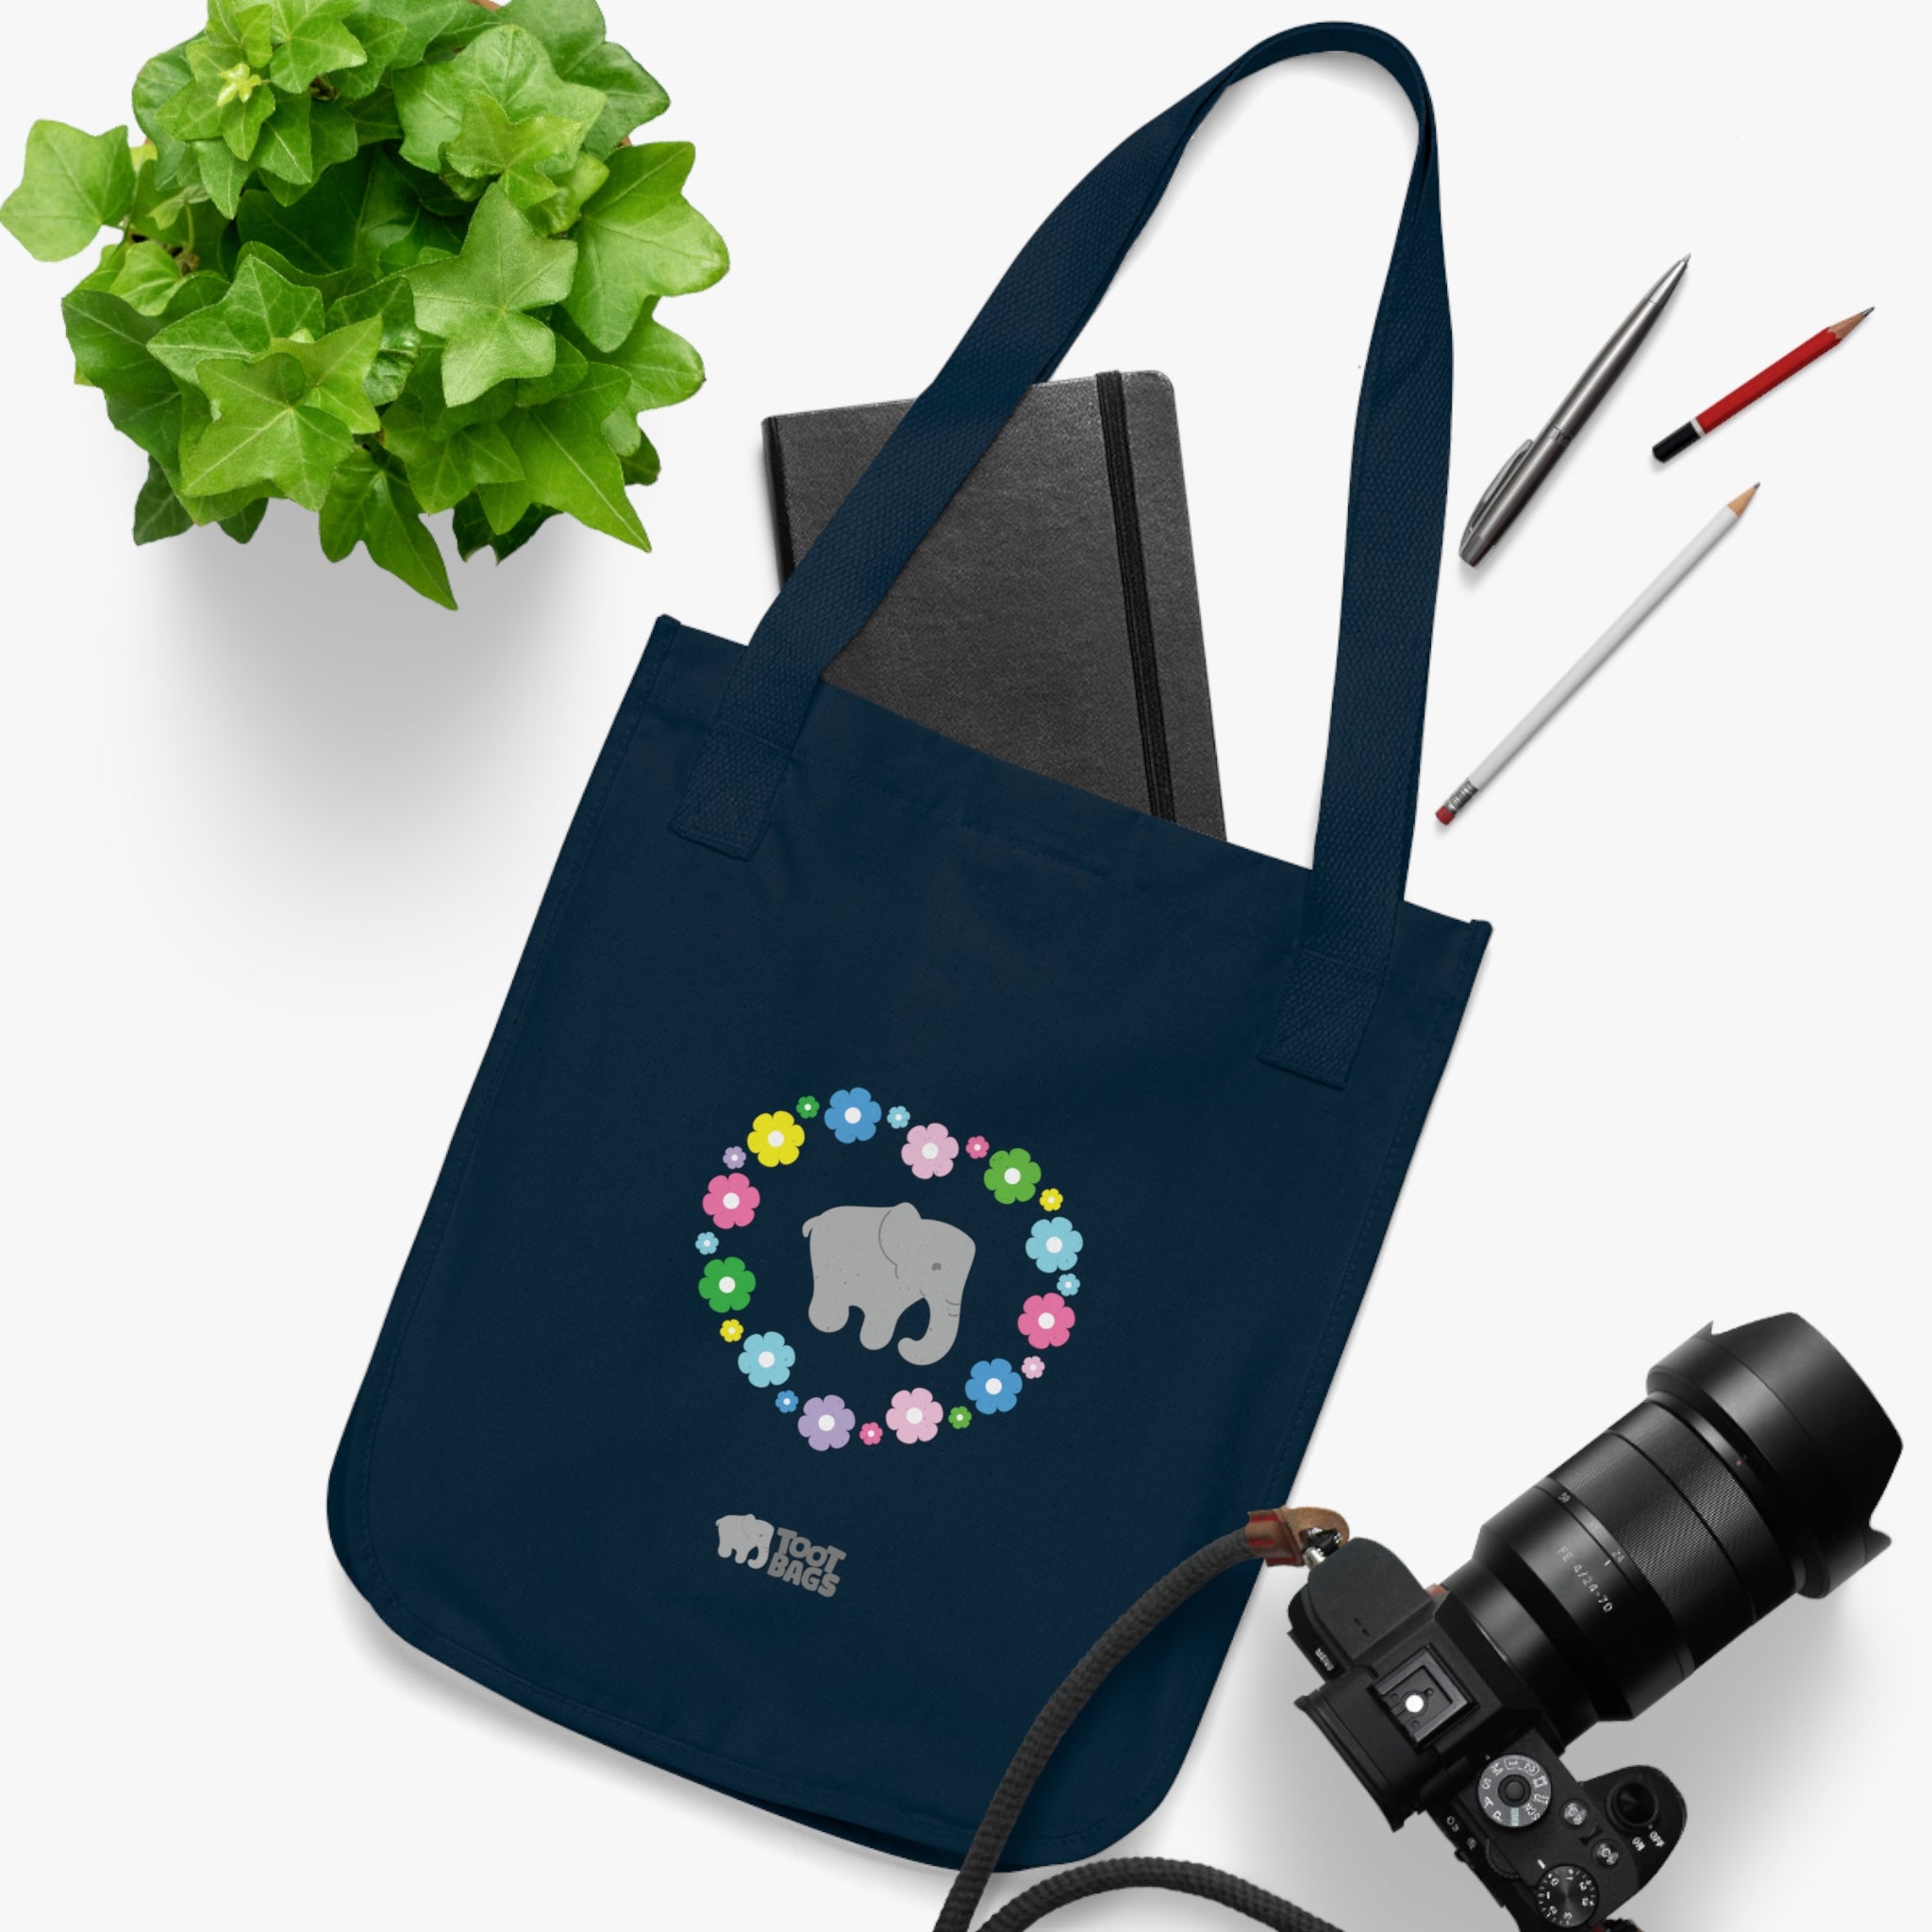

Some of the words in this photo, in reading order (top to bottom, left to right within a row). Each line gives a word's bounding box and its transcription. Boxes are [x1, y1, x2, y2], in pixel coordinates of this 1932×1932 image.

[776, 1526, 847, 1574] TOOT
[1557, 1545, 1574, 1562] FE
[767, 1552, 841, 1598] BAGS
